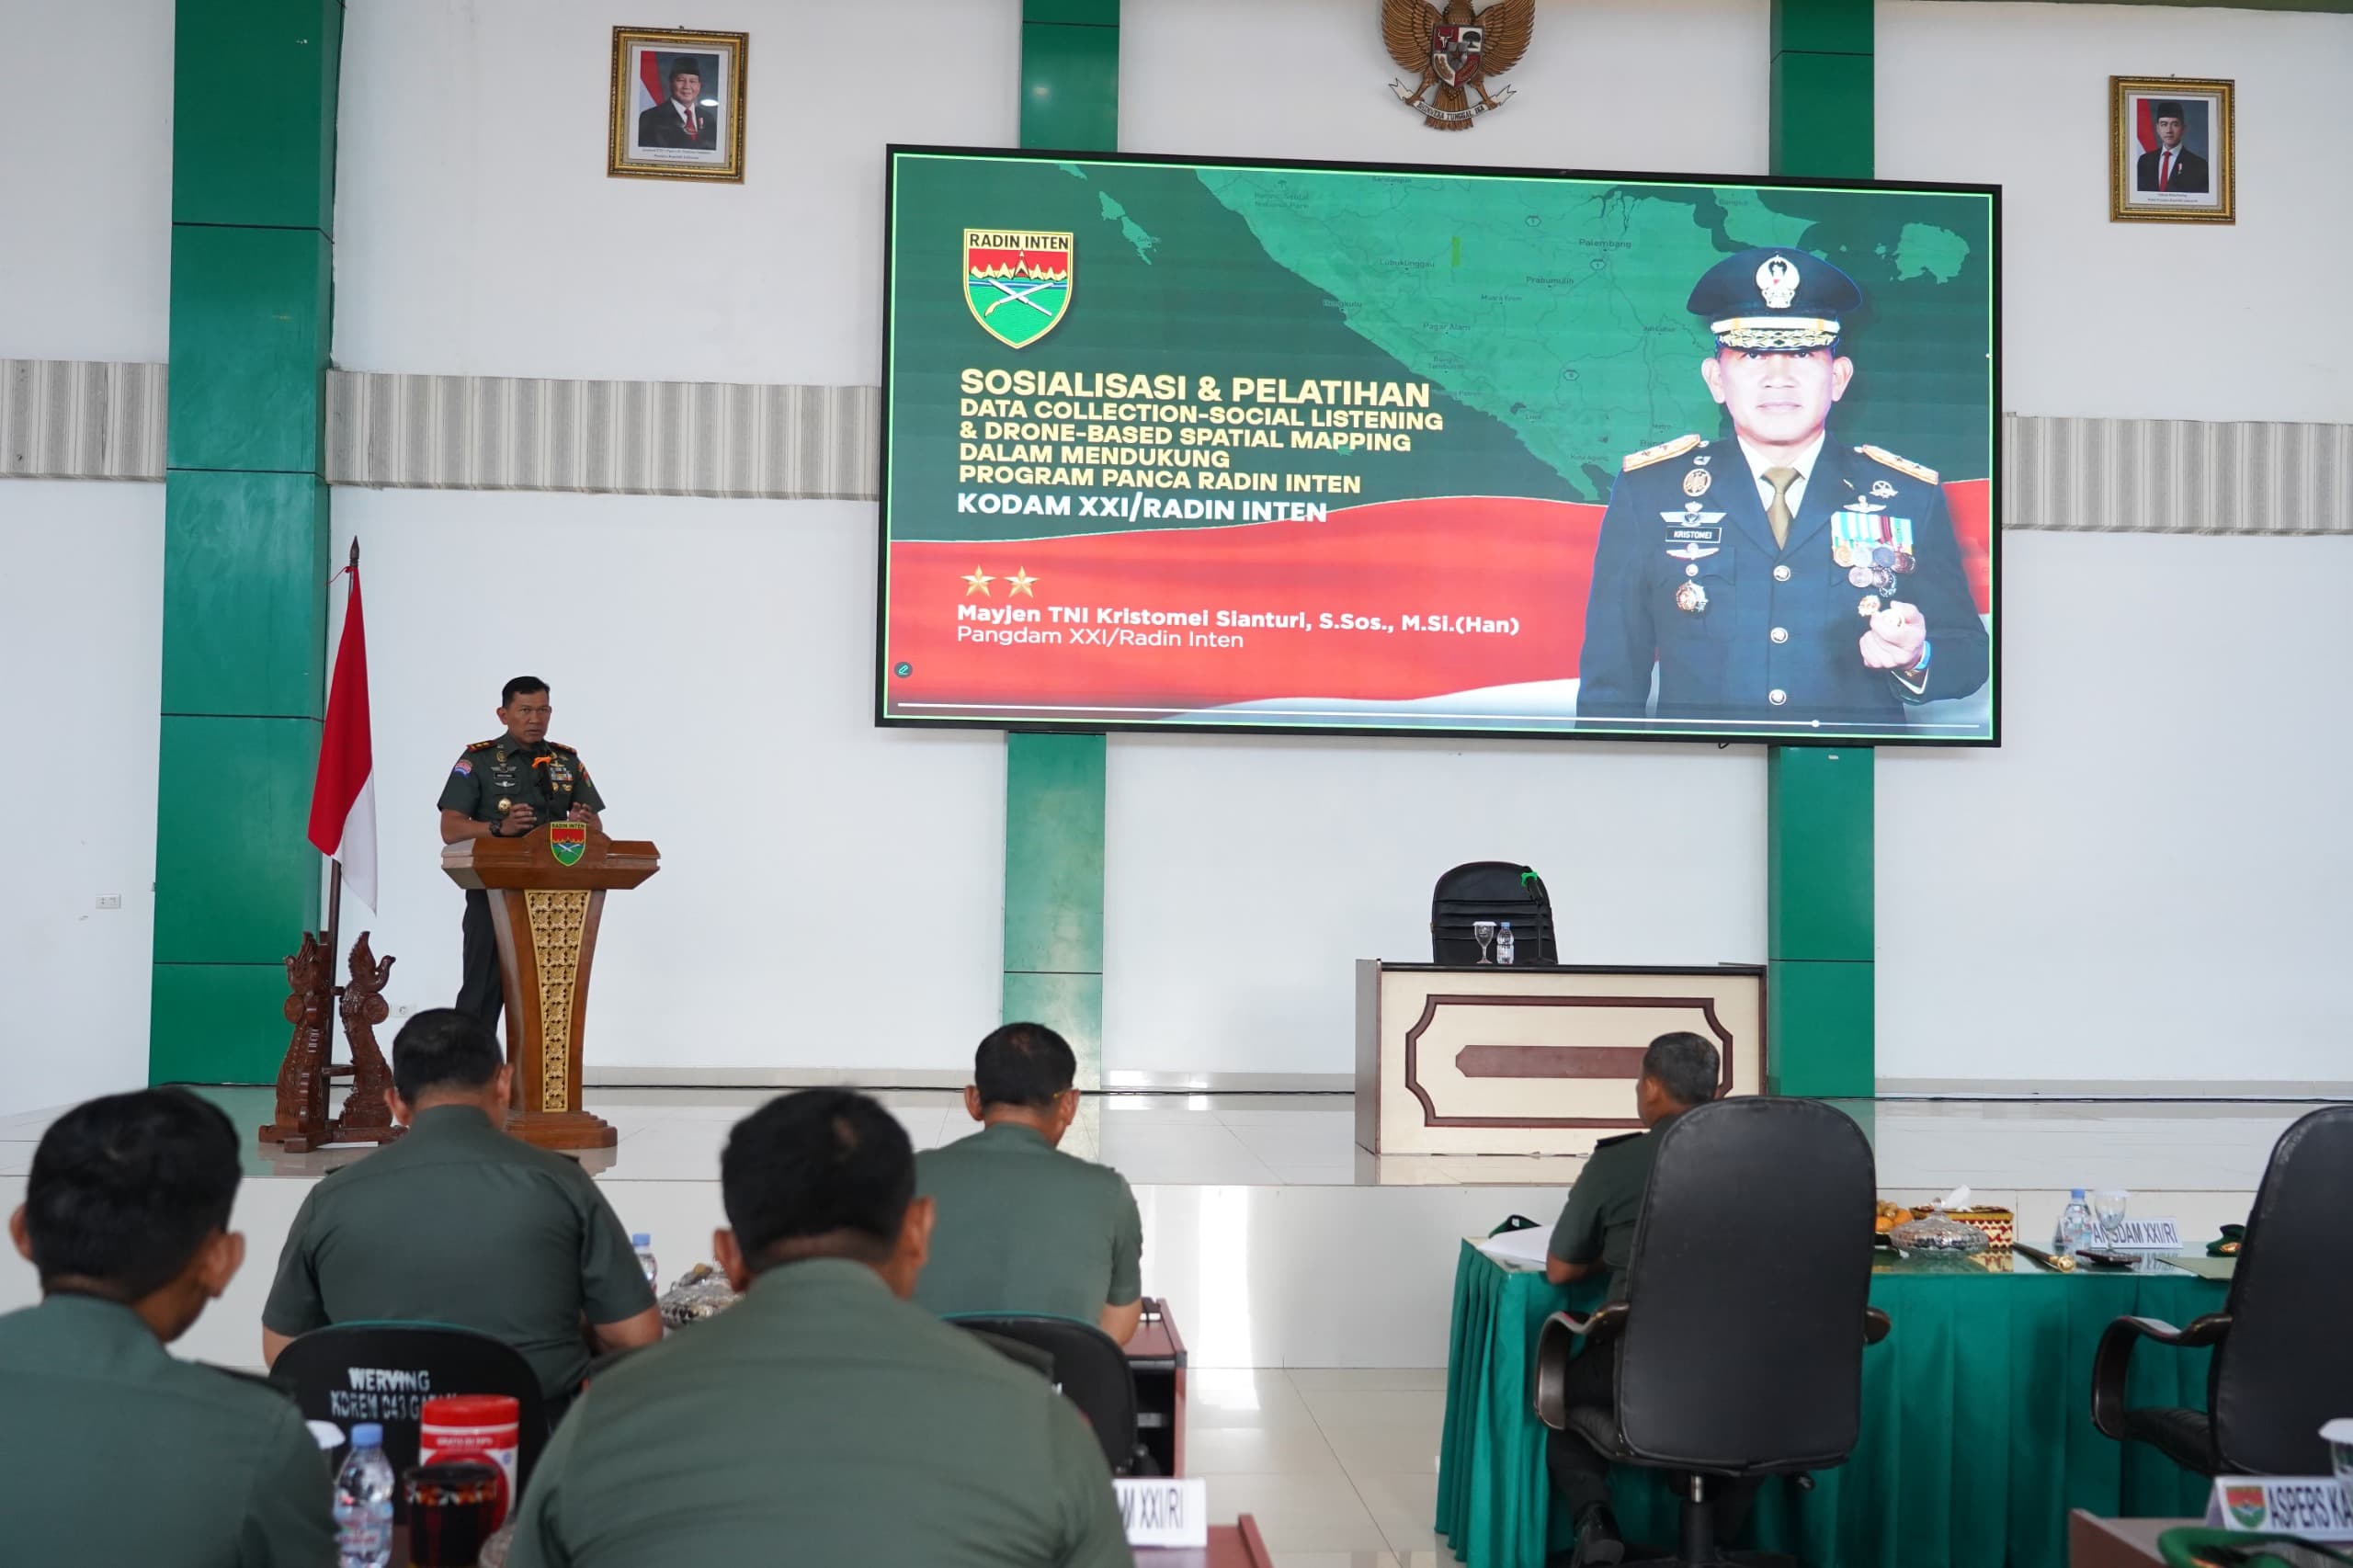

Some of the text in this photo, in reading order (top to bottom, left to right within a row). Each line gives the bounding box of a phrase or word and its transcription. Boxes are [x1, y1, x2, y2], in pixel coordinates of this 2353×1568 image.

[970, 233, 1069, 250] RADIN INTEN
[1578, 238, 1631, 249] Palembang
[961, 369, 1428, 407] SOSIALISASI & PELATIHAN
[961, 399, 1442, 429] DATA COLLECTION-SOCIAL LISTENING
[961, 421, 1410, 450] & DRONE-BASED SPATIAL MAPPING
[961, 443, 1229, 467] DALAM MENDUKUNG
[961, 465, 1359, 493] PROGRAM PANCA RADIN INTEN
[959, 492, 1327, 523] KODAM XXI/RADIN INTEN
[958, 605, 1518, 635] Mayjen TNI Kristomei Sianturi, S.Sos., M.Si.(Han)
[959, 626, 1243, 647] Pangdam XXI/Radin Inten
[348, 1368, 430, 1391] WERVING
[2268, 1486, 2330, 1528] ASPERS
